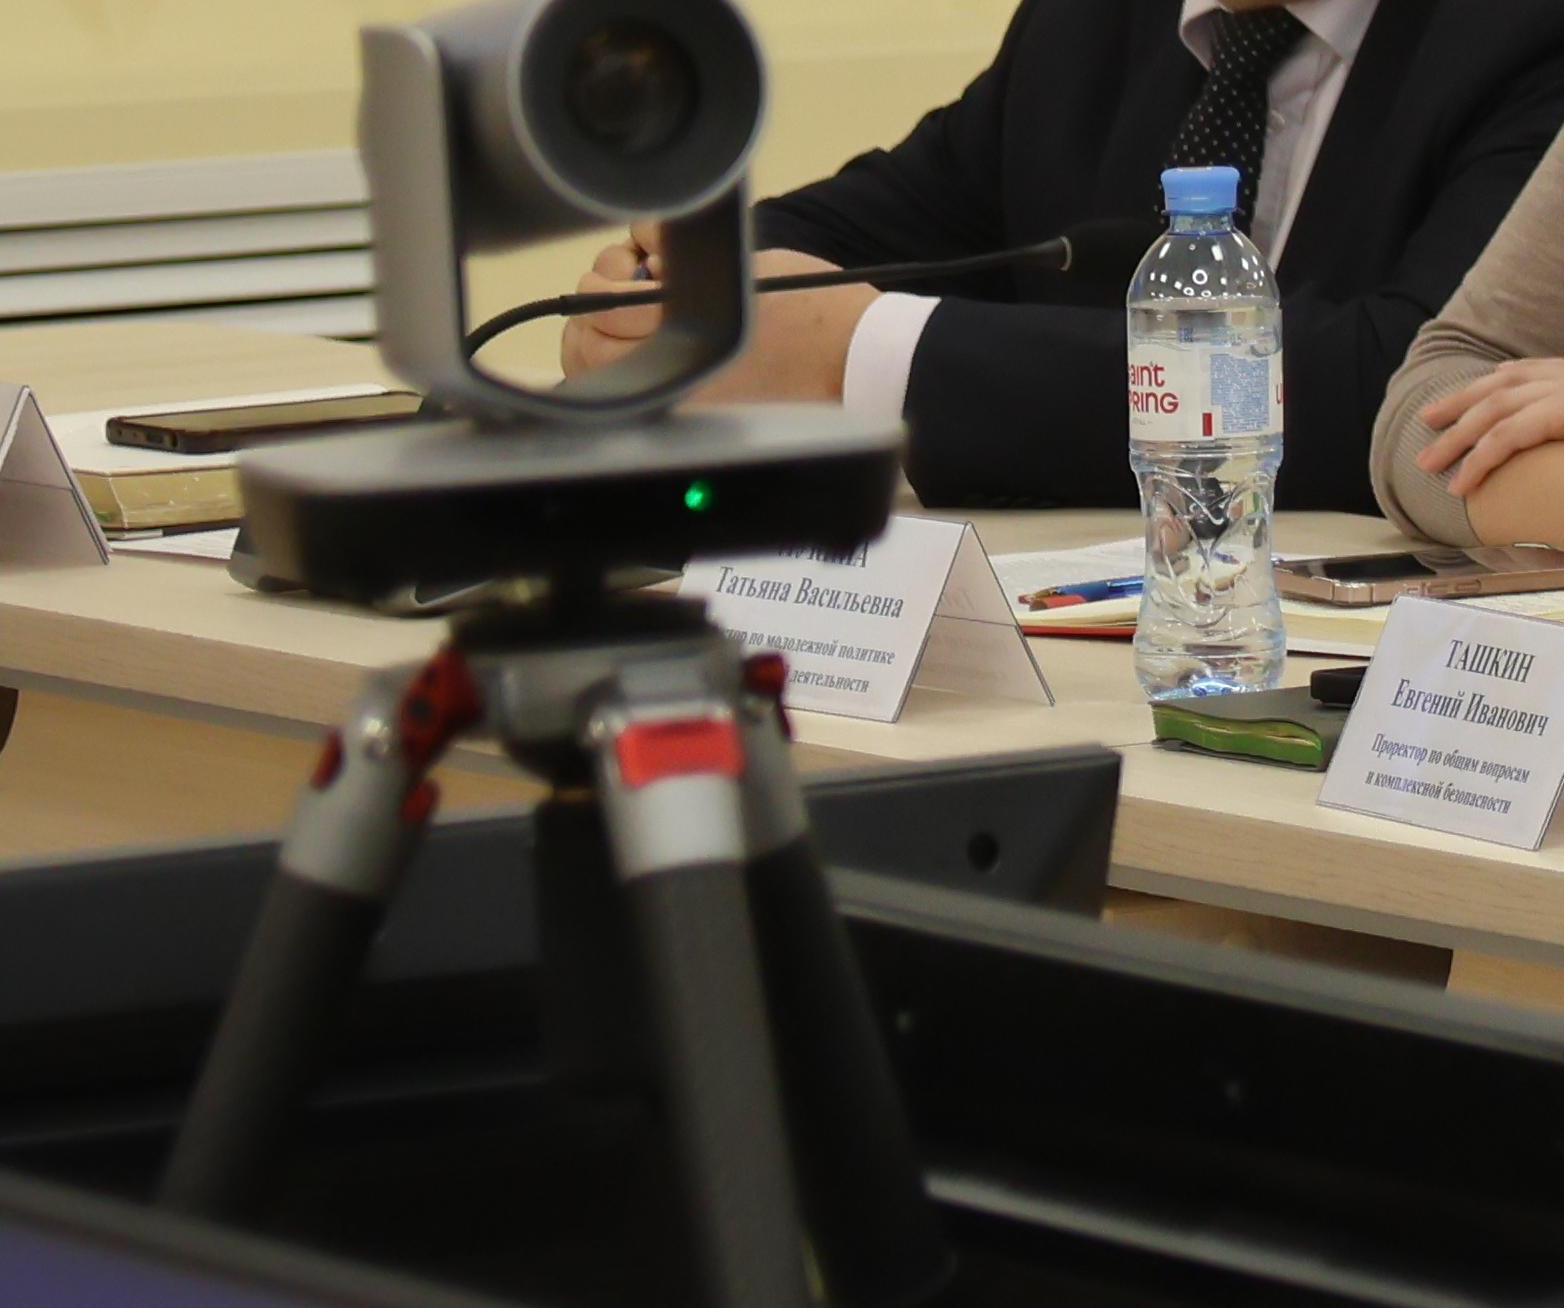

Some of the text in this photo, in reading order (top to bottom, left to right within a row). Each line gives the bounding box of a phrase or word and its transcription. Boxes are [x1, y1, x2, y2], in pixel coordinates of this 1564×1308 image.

[1129, 361, 1165, 388] aint
[716, 566, 904, 618] Татьяна Васильевна
[749, 632, 764, 647] по
[766, 635, 837, 658] молодежной
[837, 644, 896, 665] политике
[1446, 639, 1536, 683] ТАШКИН
[1391, 679, 1550, 737] Евгений Иванович
[1371, 733, 1530, 784] Проректор по общим вопросам
[1365, 770, 1512, 814] и комплексной безопасности
